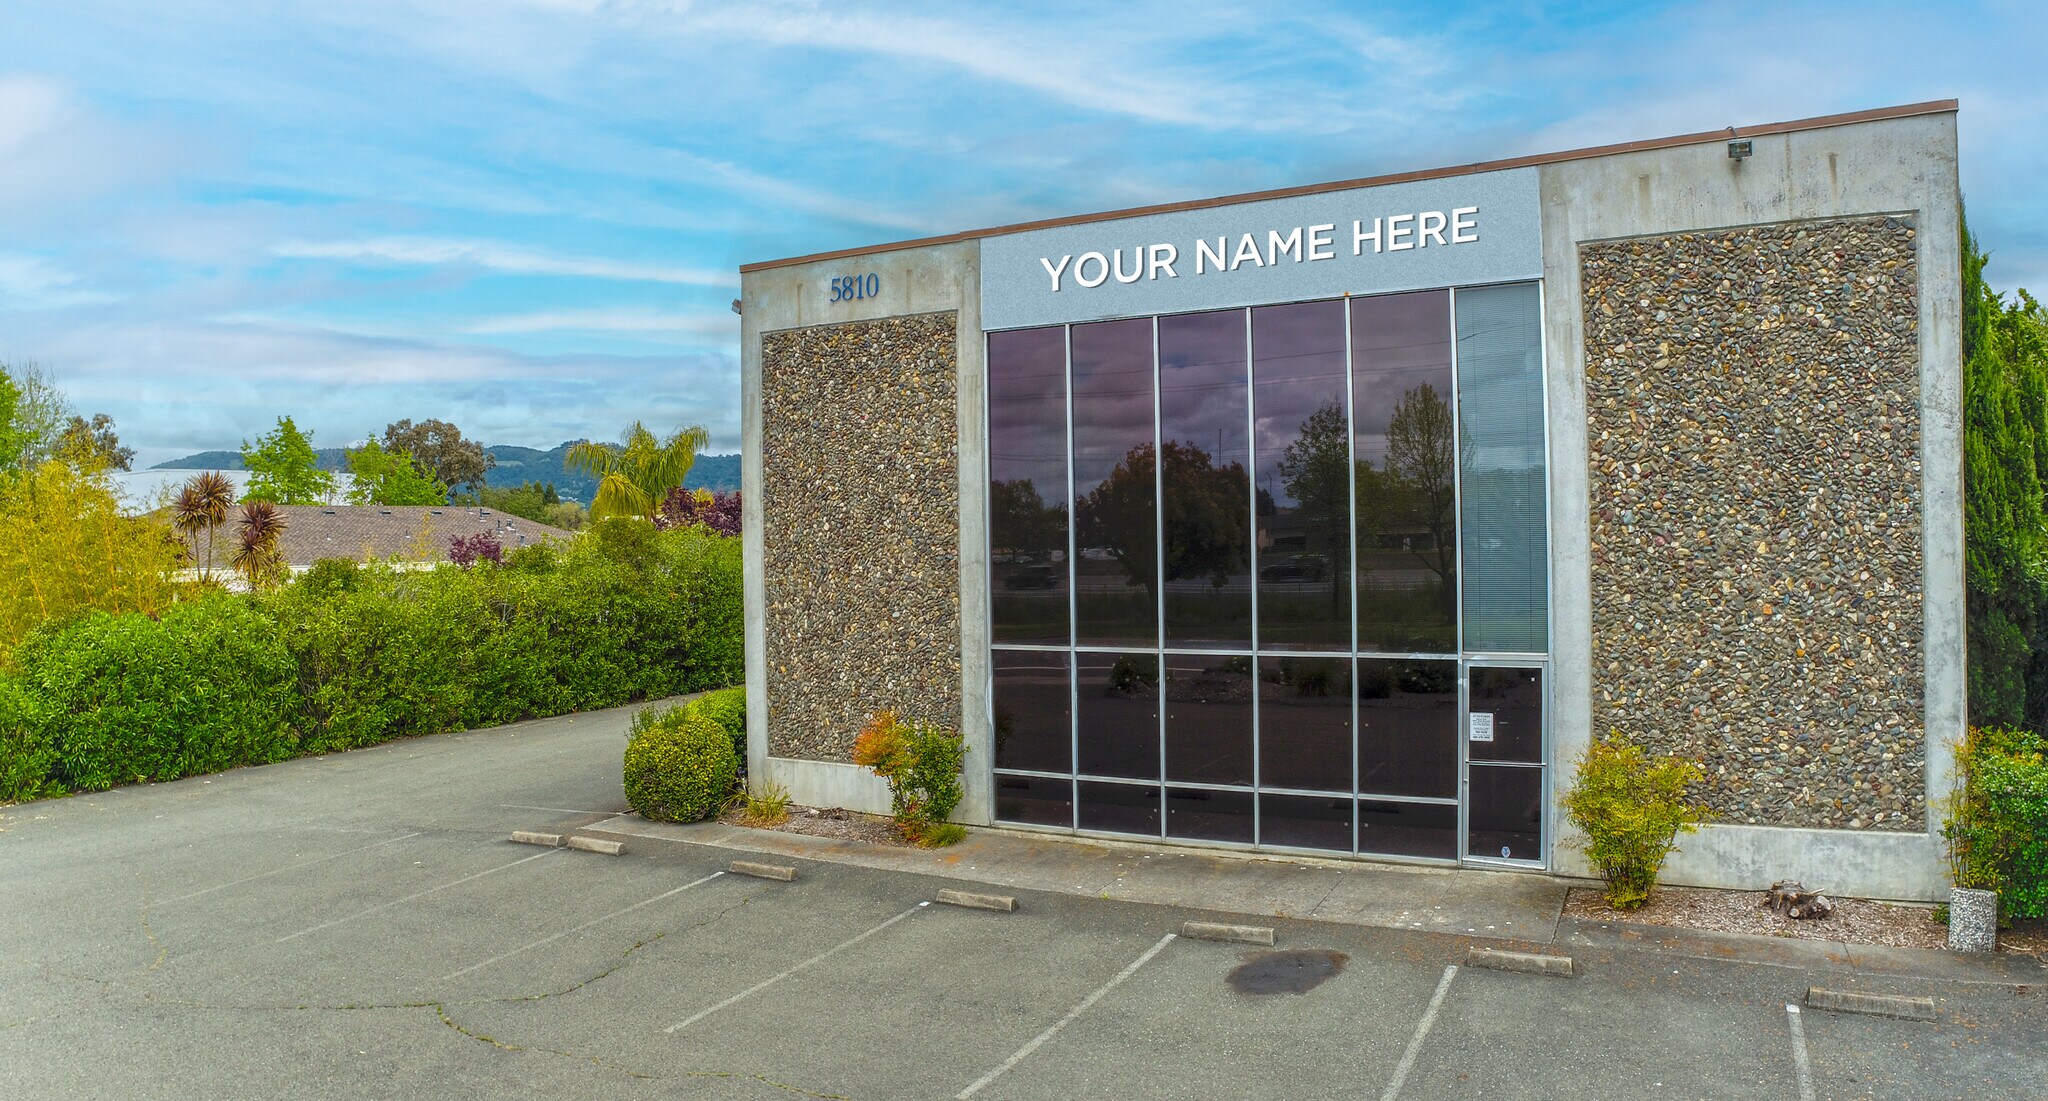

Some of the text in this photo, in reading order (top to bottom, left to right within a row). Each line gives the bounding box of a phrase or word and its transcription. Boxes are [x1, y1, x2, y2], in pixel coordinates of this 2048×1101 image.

[1040, 206, 1479, 292] YOUR NAME HERE
[830, 272, 880, 302] 5810
